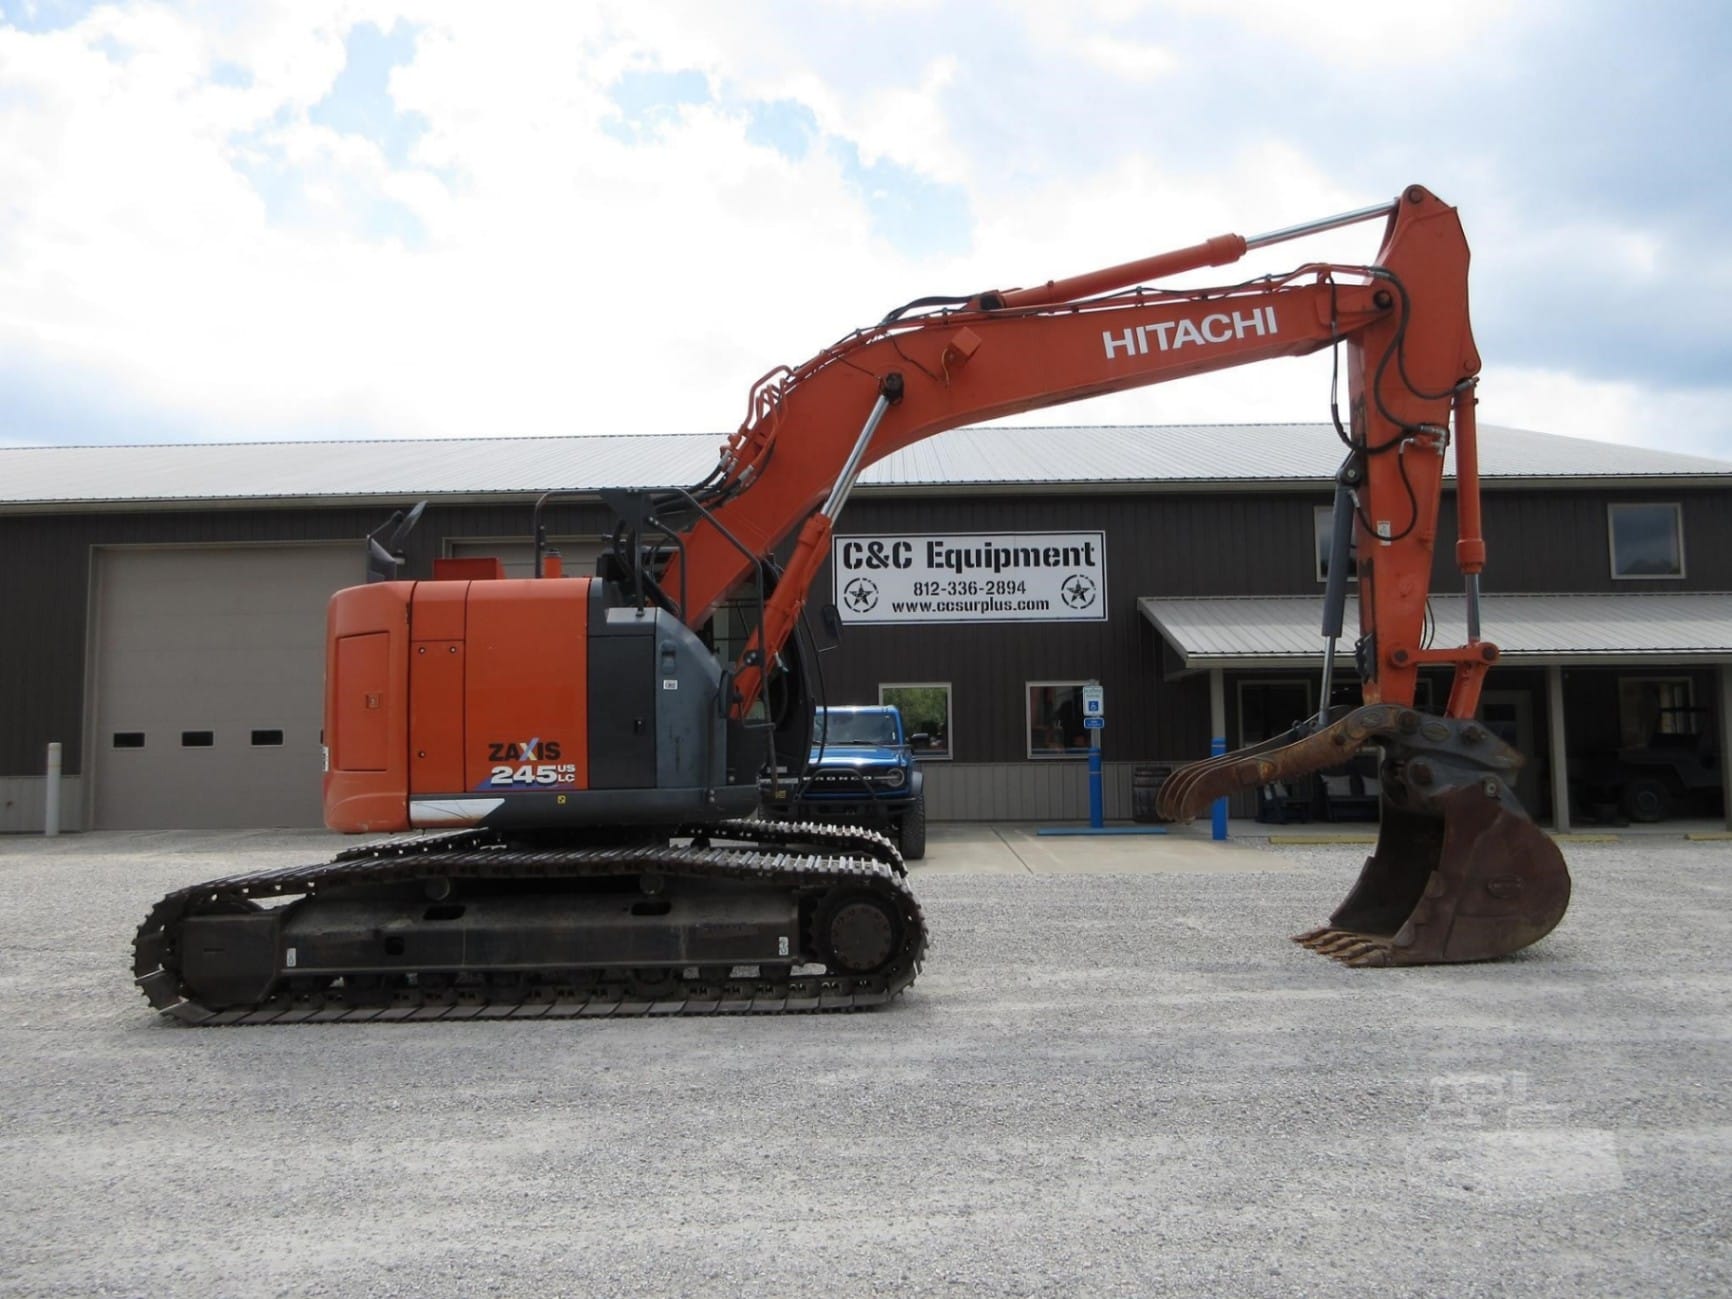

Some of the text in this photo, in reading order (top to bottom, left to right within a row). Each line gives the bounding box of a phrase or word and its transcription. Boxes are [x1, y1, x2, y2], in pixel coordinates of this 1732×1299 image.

[1102, 306, 1278, 359] HITACHI
[842, 541, 1096, 574] C&C Equipment
[913, 581, 1026, 596] 812-336-2894
[892, 597, 1050, 614] www.ccsurplus.com
[488, 738, 561, 762] ZAXIS
[490, 765, 558, 786] 245
[557, 764, 576, 773] US
[558, 774, 575, 783] LC
